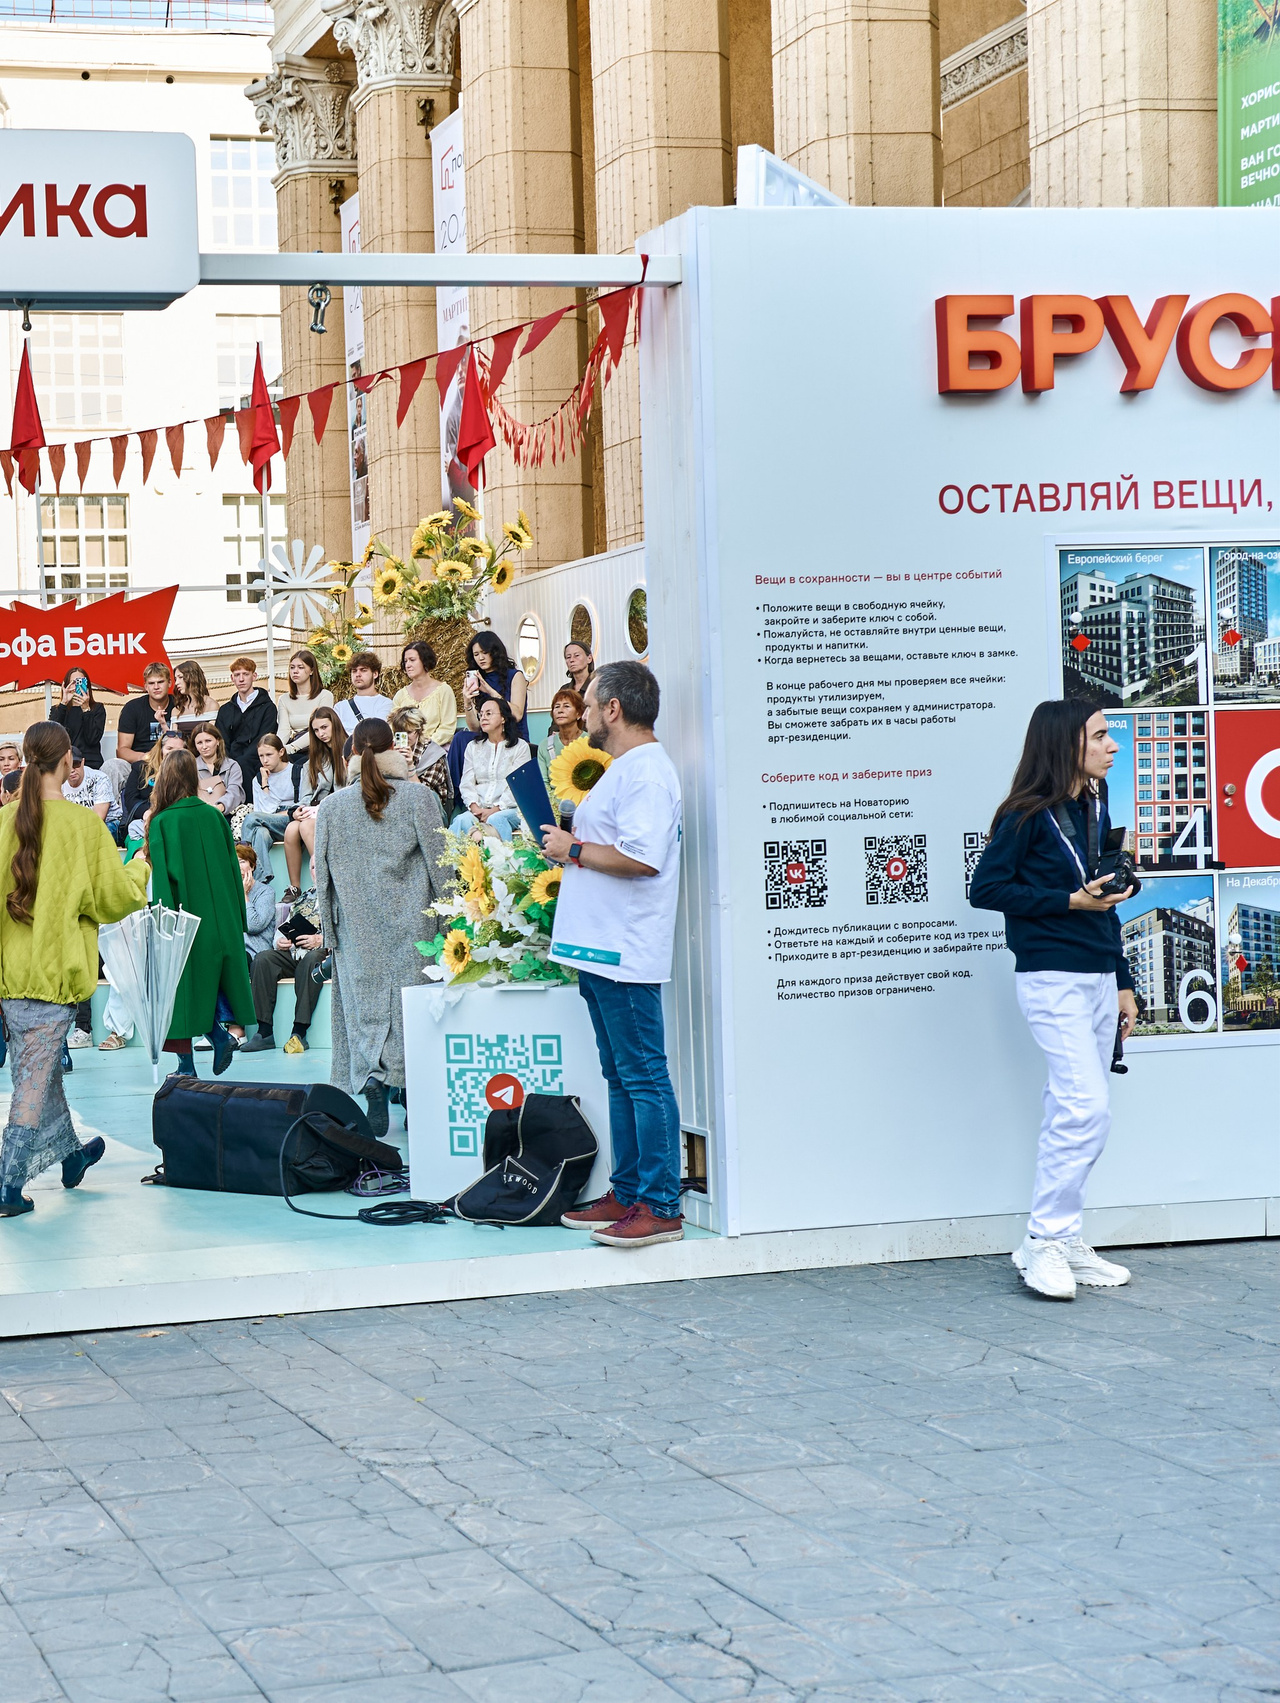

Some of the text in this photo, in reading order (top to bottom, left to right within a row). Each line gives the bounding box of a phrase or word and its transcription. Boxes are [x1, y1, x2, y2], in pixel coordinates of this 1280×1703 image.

[1240, 150, 1265, 171] ВАН
[934, 292, 1280, 394] БРУС
[938, 474, 1273, 514] ОСТАВЛЯЙ ВЕЩИ,
[1067, 553, 1163, 566] Европейский берег
[1218, 550, 1280, 561] Город-на-оз
[755, 575, 786, 585] Вещи
[789, 576, 796, 584] в
[799, 575, 870, 585] сохранности
[904, 573, 910, 581] в
[914, 572, 952, 582] центре
[955, 569, 1002, 580] событий
[763, 599, 945, 613] Положите вещи в свободную ячейку,
[764, 616, 810, 627] закройте
[821, 615, 867, 625] заберите
[869, 615, 895, 623] ключ
[905, 612, 937, 622] собой.
[763, 625, 1006, 640] Пожалуйста, не оставляйте внутри ценные вещи,
[63, 627, 148, 657] Банк
[765, 644, 814, 653] продукты
[825, 642, 868, 650] напитки.
[764, 656, 793, 665] Когда
[796, 655, 847, 665] вернетесь
[863, 654, 904, 662] вещами,
[906, 652, 949, 660] оставьте
[951, 651, 976, 659] ключ
[987, 650, 1018, 658] замке.
[1184, 643, 1206, 705] 1
[766, 681, 774, 691] В
[776, 682, 806, 691] конце
[808, 680, 854, 691] рабочего
[856, 680, 875, 689] дня
[894, 678, 947, 688] проверяем
[950, 677, 967, 685] все
[969, 674, 1006, 684] ячейки:
[767, 693, 885, 705] продукты утилизируем,
[767, 702, 996, 717] а забытые вещи сохраняем у администратора.
[768, 720, 782, 730] Вы
[785, 720, 828, 729] сможете
[830, 718, 869, 729] забрать
[894, 717, 918, 725] часы
[920, 714, 956, 726] работы
[768, 733, 851, 744] арт-резиденции.
[761, 772, 815, 784] Соберите
[819, 773, 839, 782] код
[852, 769, 903, 781] заберите
[906, 769, 932, 779] приз
[769, 801, 837, 812] Подпишитесь
[854, 798, 910, 808] Новаторию
[779, 813, 825, 823] любимой
[827, 810, 886, 822] социальной
[888, 811, 914, 819] сети:
[1172, 808, 1212, 869] 4
[1226, 876, 1280, 888] На Декабр
[773, 927, 830, 938] Дождитесь
[832, 923, 891, 935] публикации
[902, 920, 958, 930] вопросами.
[774, 940, 819, 949] Ответьте
[836, 935, 875, 946] каждый
[886, 933, 932, 944] соберите
[934, 933, 952, 941] код
[967, 931, 990, 941] трех
[775, 952, 829, 963] Приходите
[840, 947, 922, 960] арт-резиденцию
[932, 942, 983, 954] забирайте
[776, 969, 973, 989] Для каждого приза действует свой код.
[777, 985, 935, 1000] Количество призов ограничено.
[1178, 968, 1217, 1032] 6
